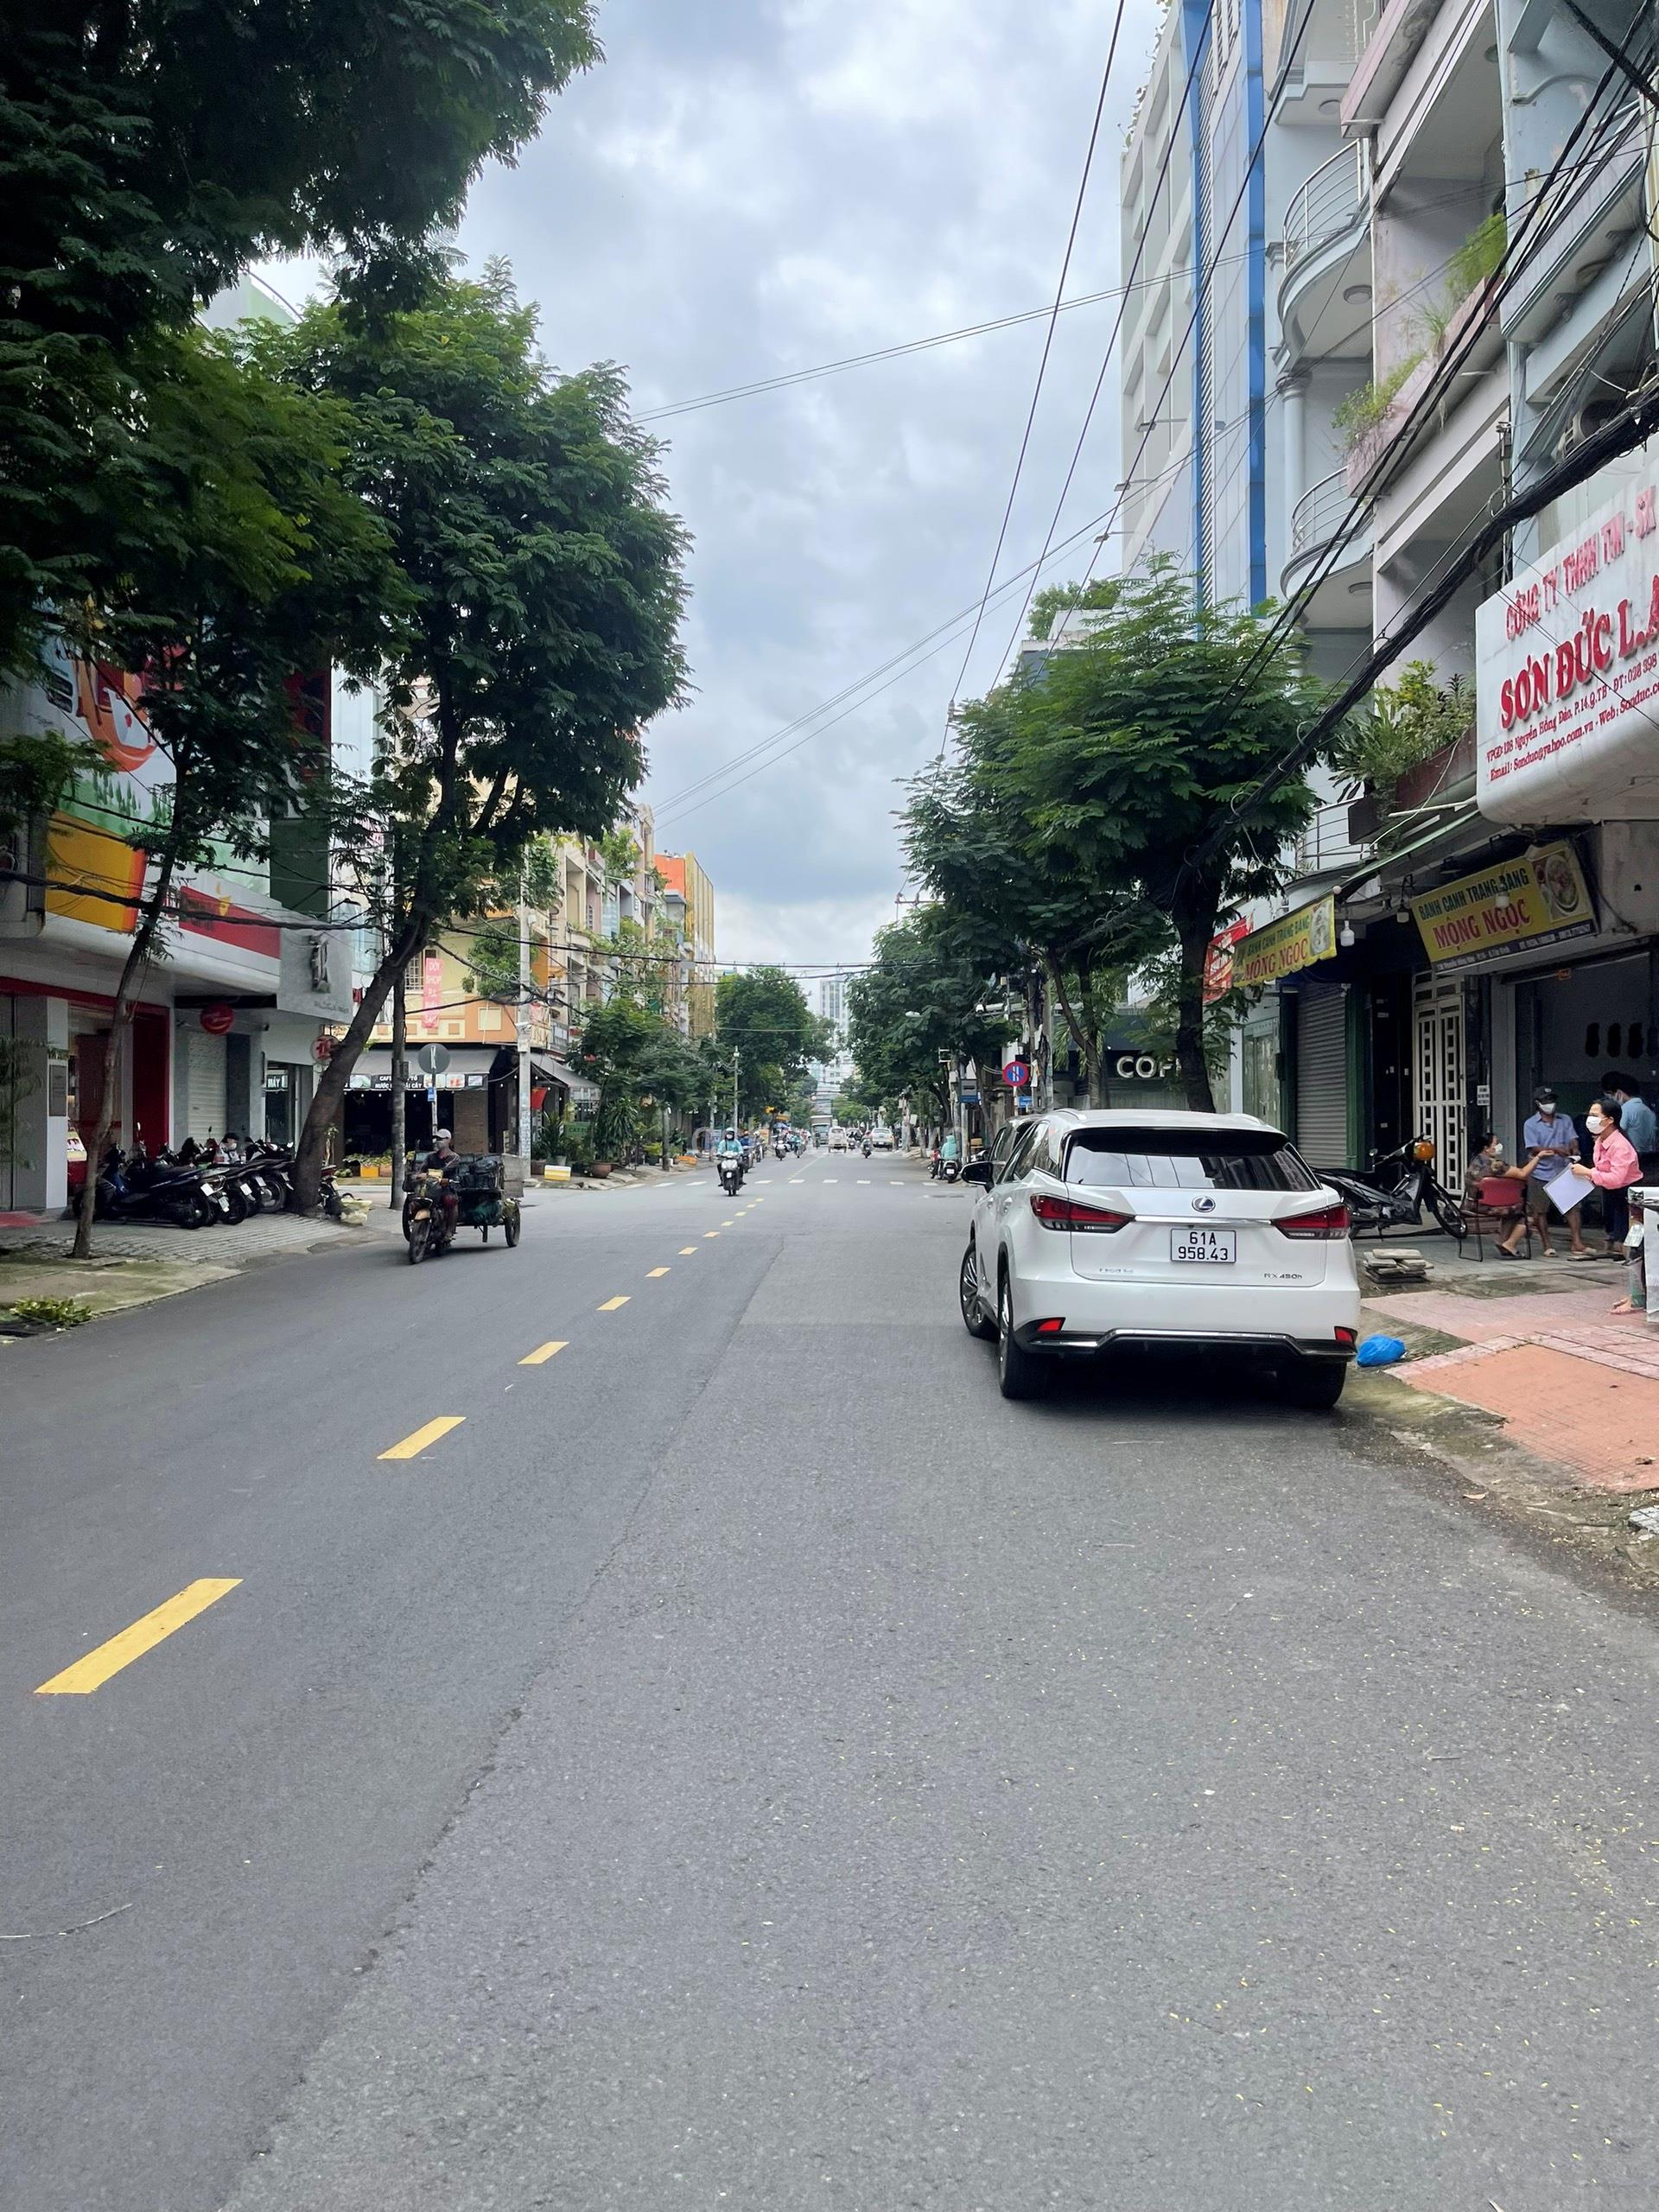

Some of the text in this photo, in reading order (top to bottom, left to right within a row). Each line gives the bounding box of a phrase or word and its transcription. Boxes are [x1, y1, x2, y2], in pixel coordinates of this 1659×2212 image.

[1542, 565, 1559, 613] TY
[1501, 652, 1551, 729] SƠN
[1555, 607, 1612, 699] ĐỨC
[1116, 1055, 1182, 1078] COF
[1189, 1231, 1217, 1245] 61A
[1178, 1247, 1229, 1261] 958.43
